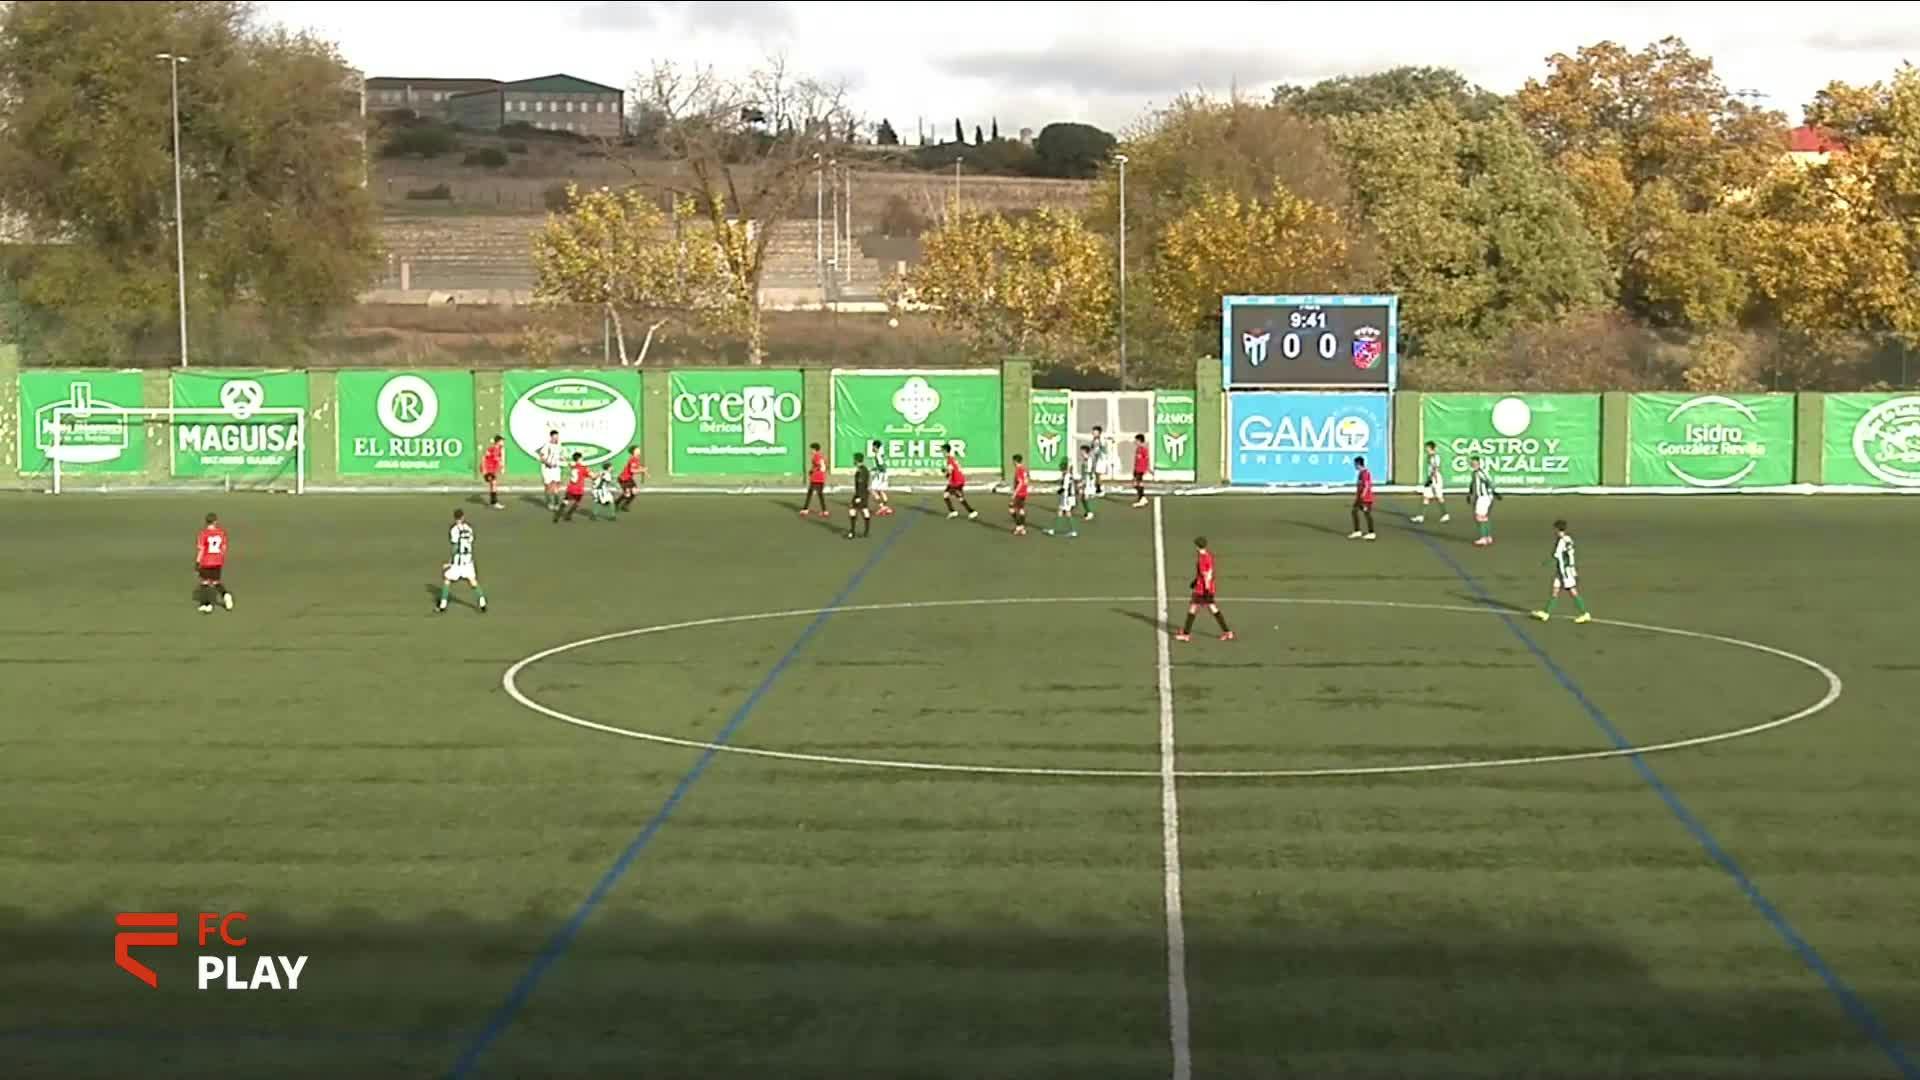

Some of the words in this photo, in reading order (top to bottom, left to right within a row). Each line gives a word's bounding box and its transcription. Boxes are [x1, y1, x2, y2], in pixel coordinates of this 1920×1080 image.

[1290, 312, 1325, 328] 9:41
[1283, 333, 1300, 358] 0
[1319, 333, 1337, 358] 0
[673, 391, 802, 434] crego
[179, 424, 305, 451] MAGUISA
[1239, 415, 1370, 448] GAMO
[1686, 423, 1742, 442] Isidro
[354, 438, 384, 457] EL
[389, 438, 463, 457] RUBIO
[1451, 438, 1539, 454] CASTRO
[1544, 438, 1560, 454] Y
[1657, 441, 1717, 456] González
[1240, 453, 1368, 465] ENERGIA
[207, 535, 222, 553] 12
